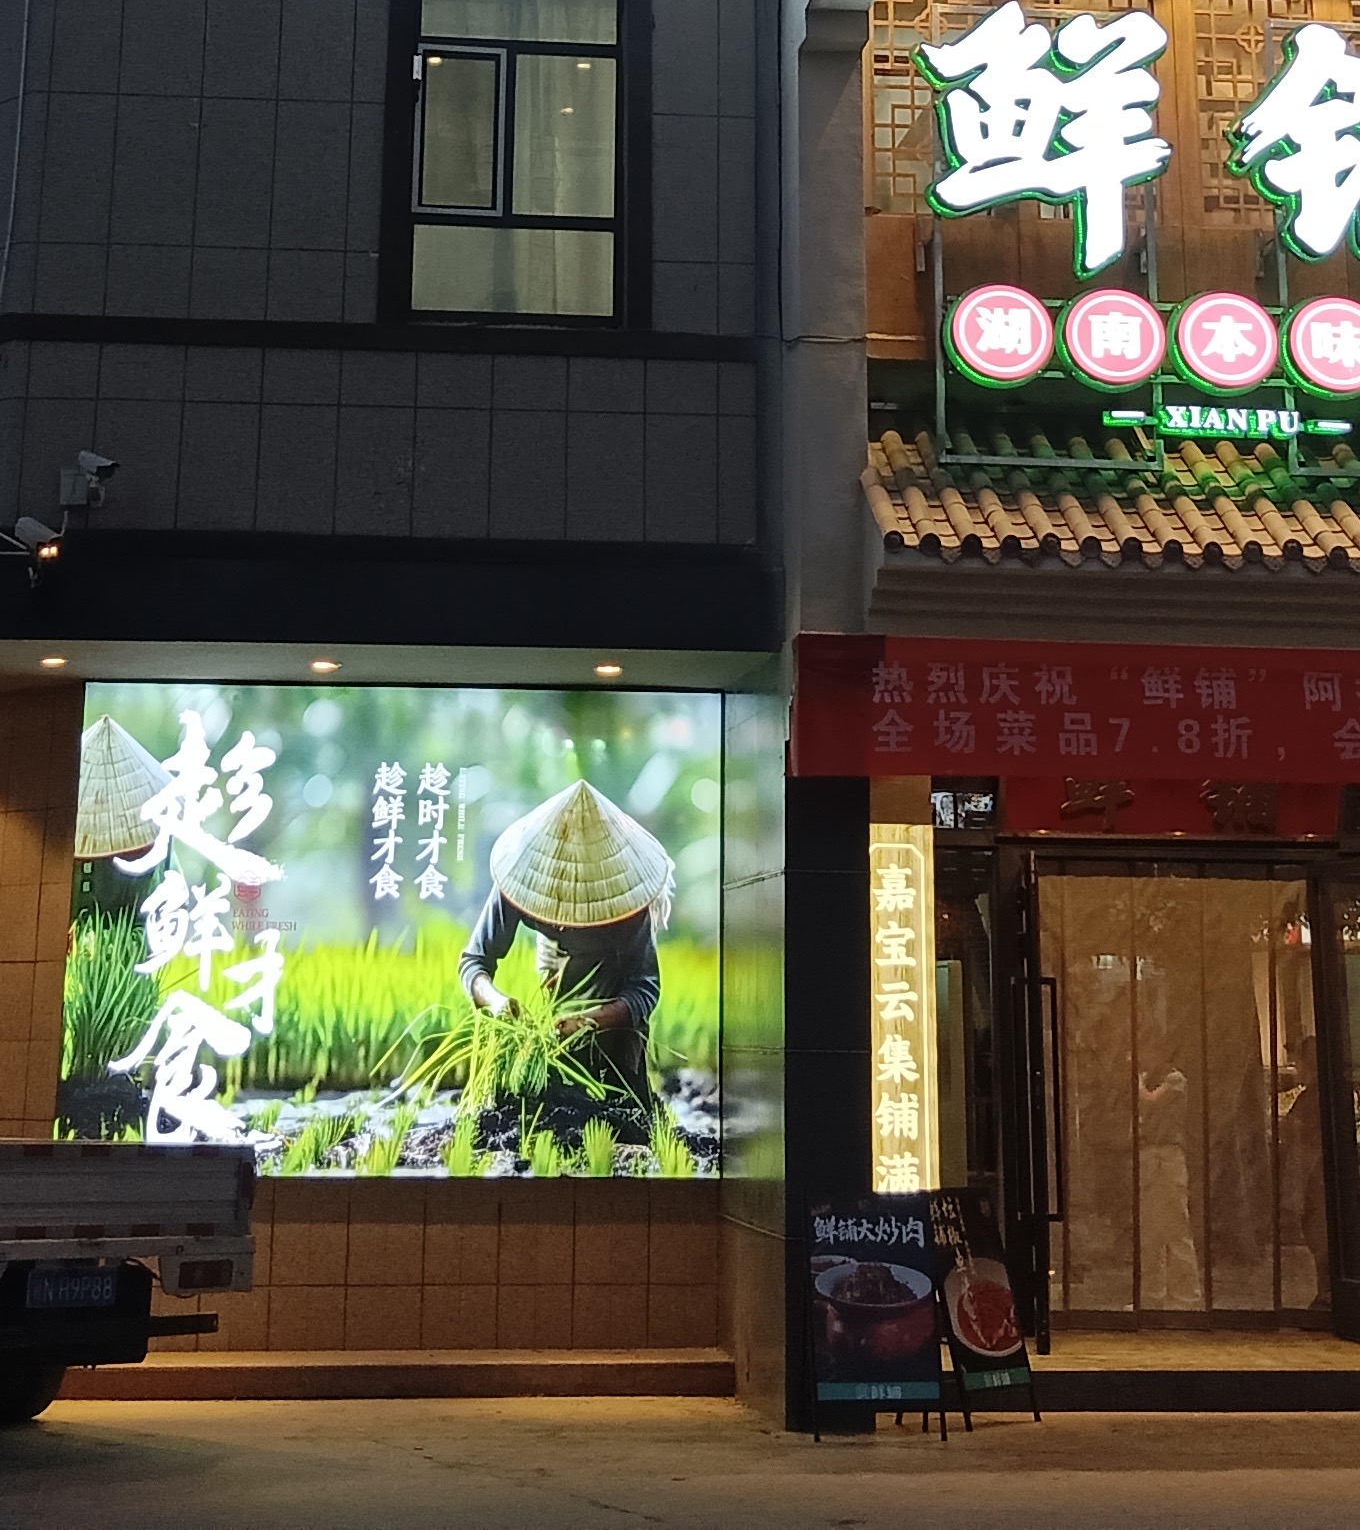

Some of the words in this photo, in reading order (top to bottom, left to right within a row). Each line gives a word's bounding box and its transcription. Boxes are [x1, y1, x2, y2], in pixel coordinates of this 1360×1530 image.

[369, 761, 407, 899] 趁鲜才食
[413, 762, 451, 899] 趁时才食
